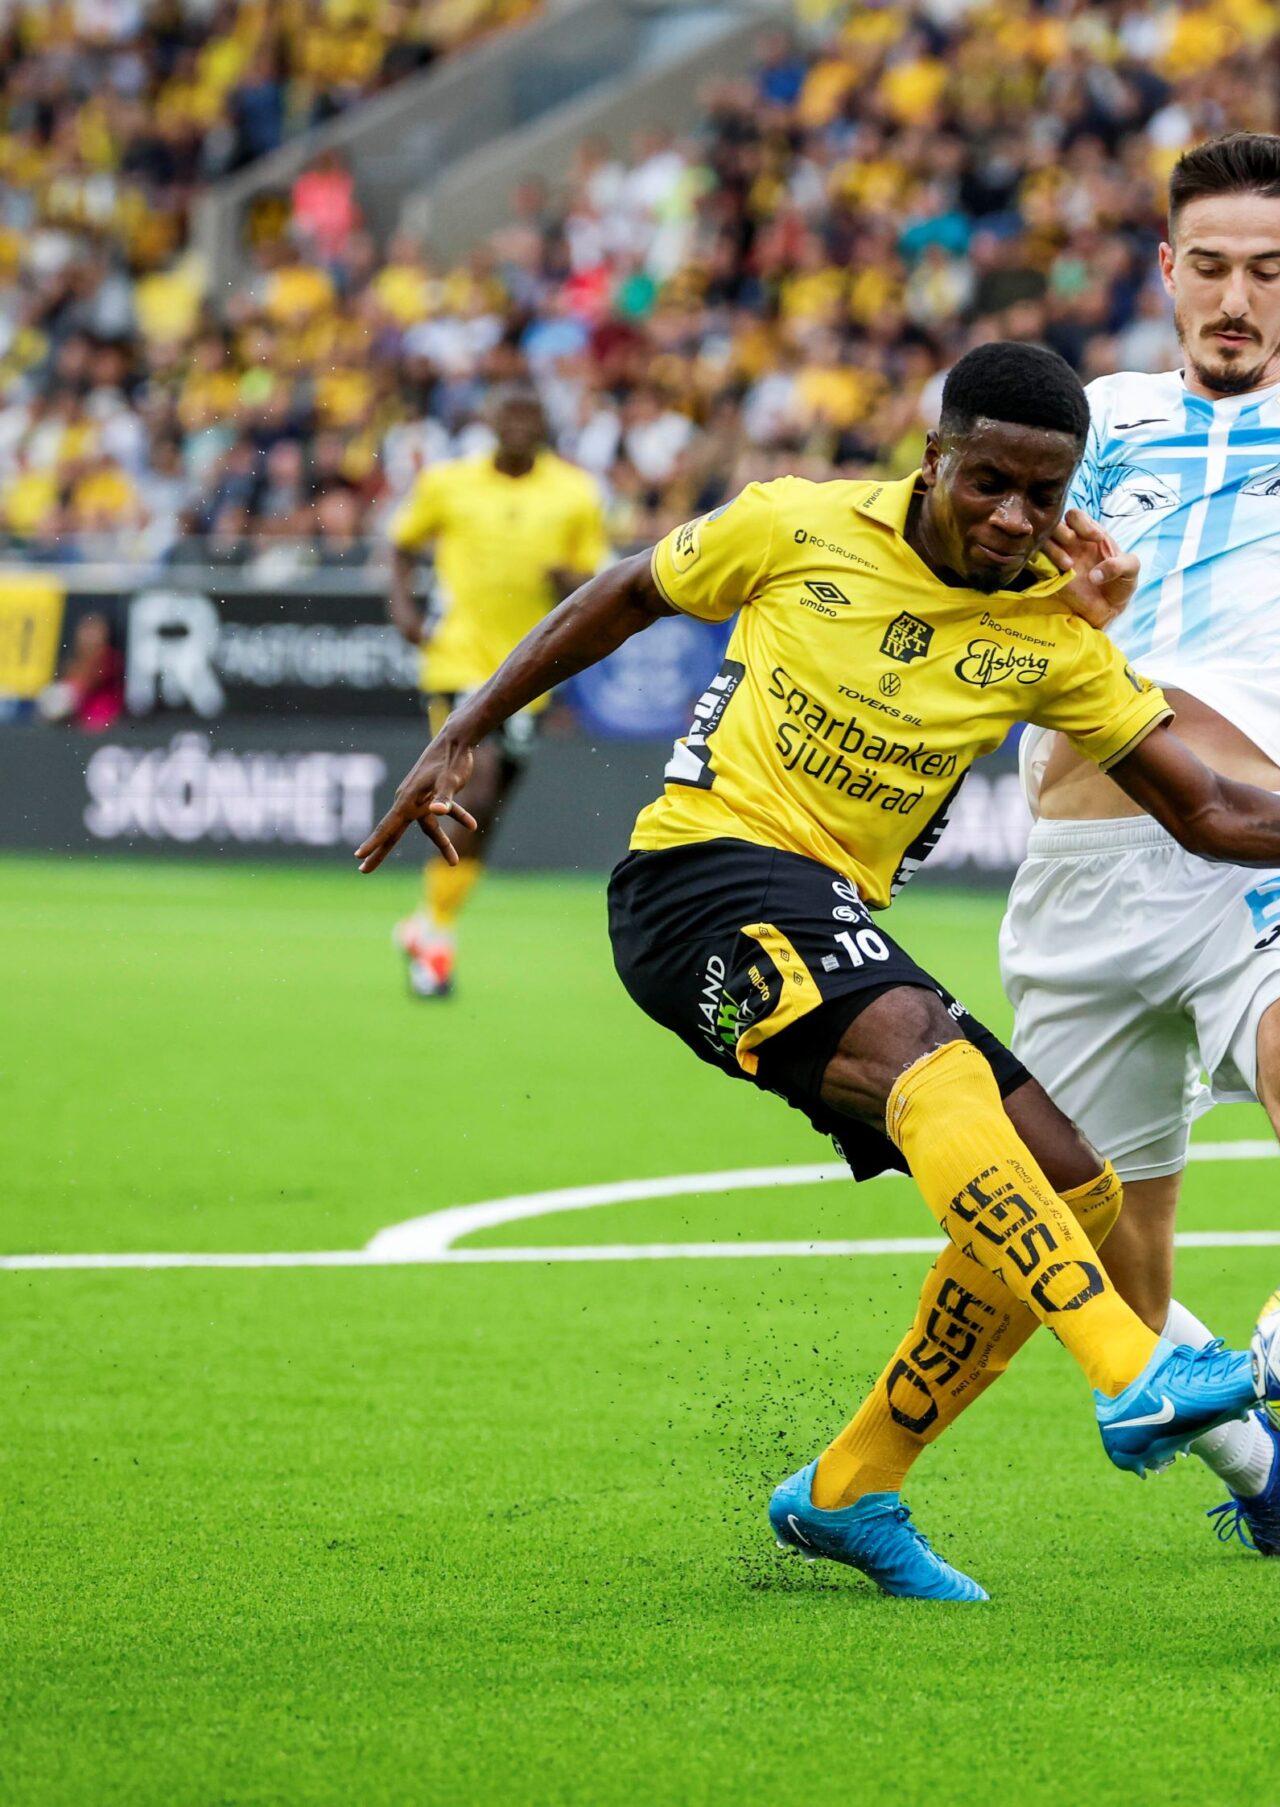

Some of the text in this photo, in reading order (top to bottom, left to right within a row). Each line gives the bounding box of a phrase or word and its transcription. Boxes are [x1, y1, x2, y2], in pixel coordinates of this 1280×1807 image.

[809, 535, 879, 571] RO-GRUPPEN
[799, 597, 837, 618] umbro
[889, 625, 926, 653] EKT
[987, 619, 1056, 648] RO-GRUPPEN
[954, 638, 1050, 689] Elfsborg
[768, 667, 958, 777] Sparbanken
[837, 684, 923, 727] TOVEKS BIL
[775, 722, 925, 815] Sjuhärad
[833, 928, 890, 968] 10
[748, 964, 771, 1002] umbro
[1057, 1221, 1074, 1242] PART
